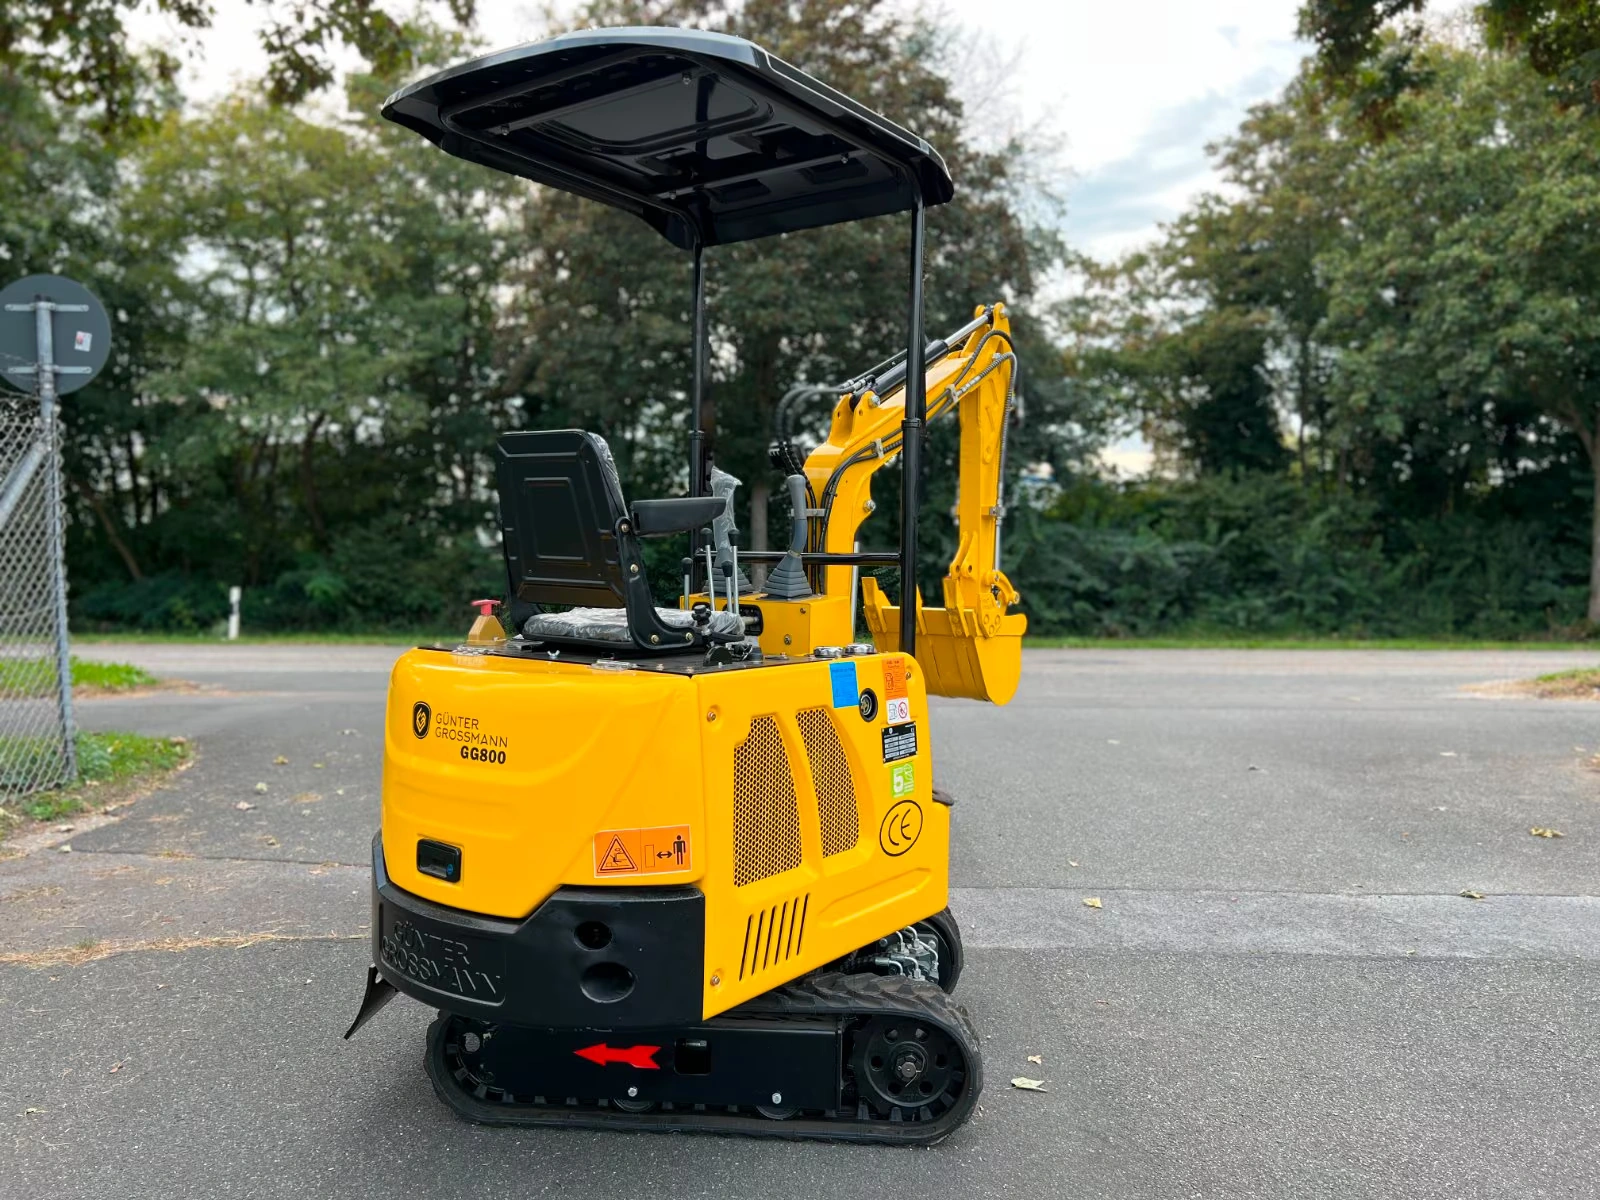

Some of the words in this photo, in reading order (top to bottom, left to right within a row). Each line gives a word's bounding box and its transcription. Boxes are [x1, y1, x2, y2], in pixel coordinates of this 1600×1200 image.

[435, 711, 479, 730] GÜNTER
[435, 726, 508, 748] GROSSMANN
[460, 745, 506, 765] GG800
[888, 808, 912, 846] CE
